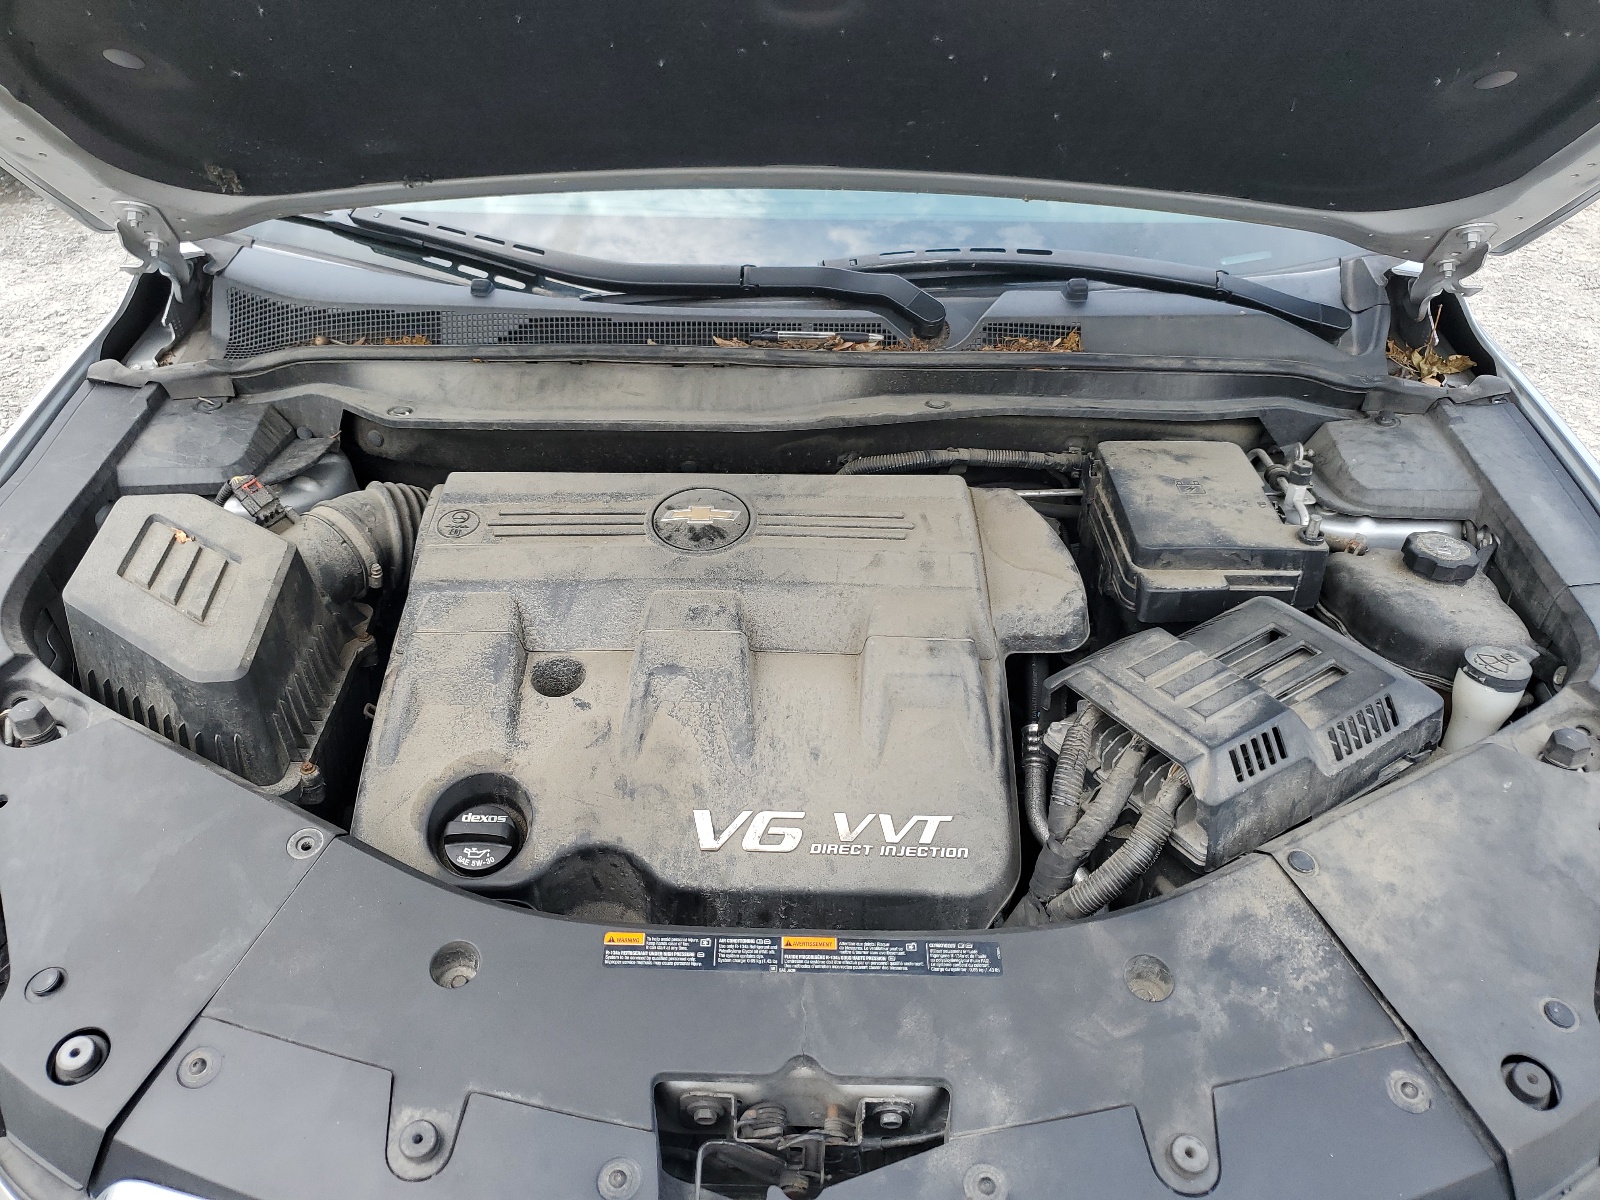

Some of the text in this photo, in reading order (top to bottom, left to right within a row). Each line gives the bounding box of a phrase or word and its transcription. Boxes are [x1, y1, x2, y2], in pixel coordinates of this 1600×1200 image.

[461, 812, 509, 823] dexos
[693, 809, 954, 853] V6 VVT
[810, 843, 969, 858] DIRECT INJECTION
[456, 855, 495, 867] SAE 5W-30
